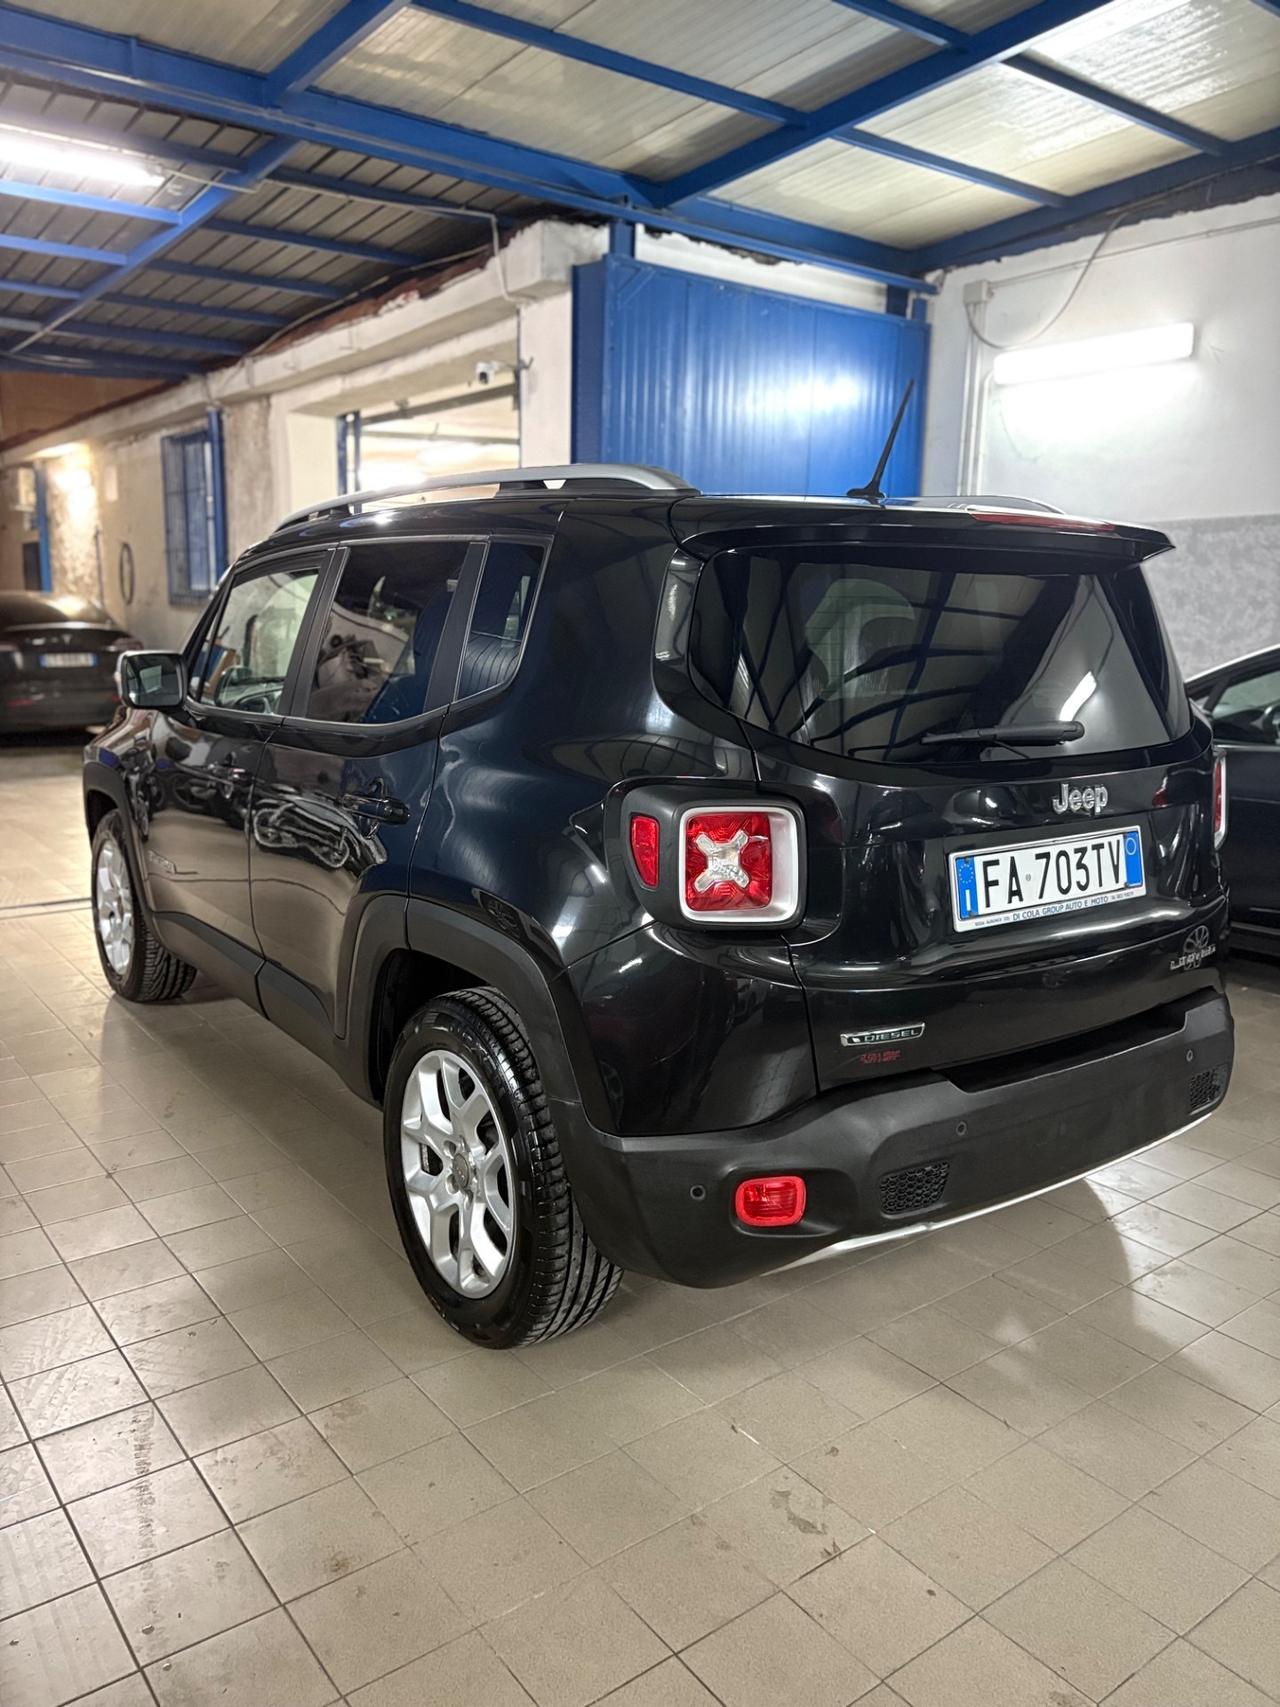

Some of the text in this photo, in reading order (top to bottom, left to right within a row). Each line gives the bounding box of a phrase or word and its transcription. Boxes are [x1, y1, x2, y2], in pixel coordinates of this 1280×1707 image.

[1053, 783, 1108, 814] Jeep
[1022, 909, 1040, 919] COLA
[1042, 904, 1064, 915] GROUP
[1065, 901, 1083, 910] AUTO
[1091, 896, 1109, 905] MOTO
[864, 1030, 919, 1042] DIESEL
